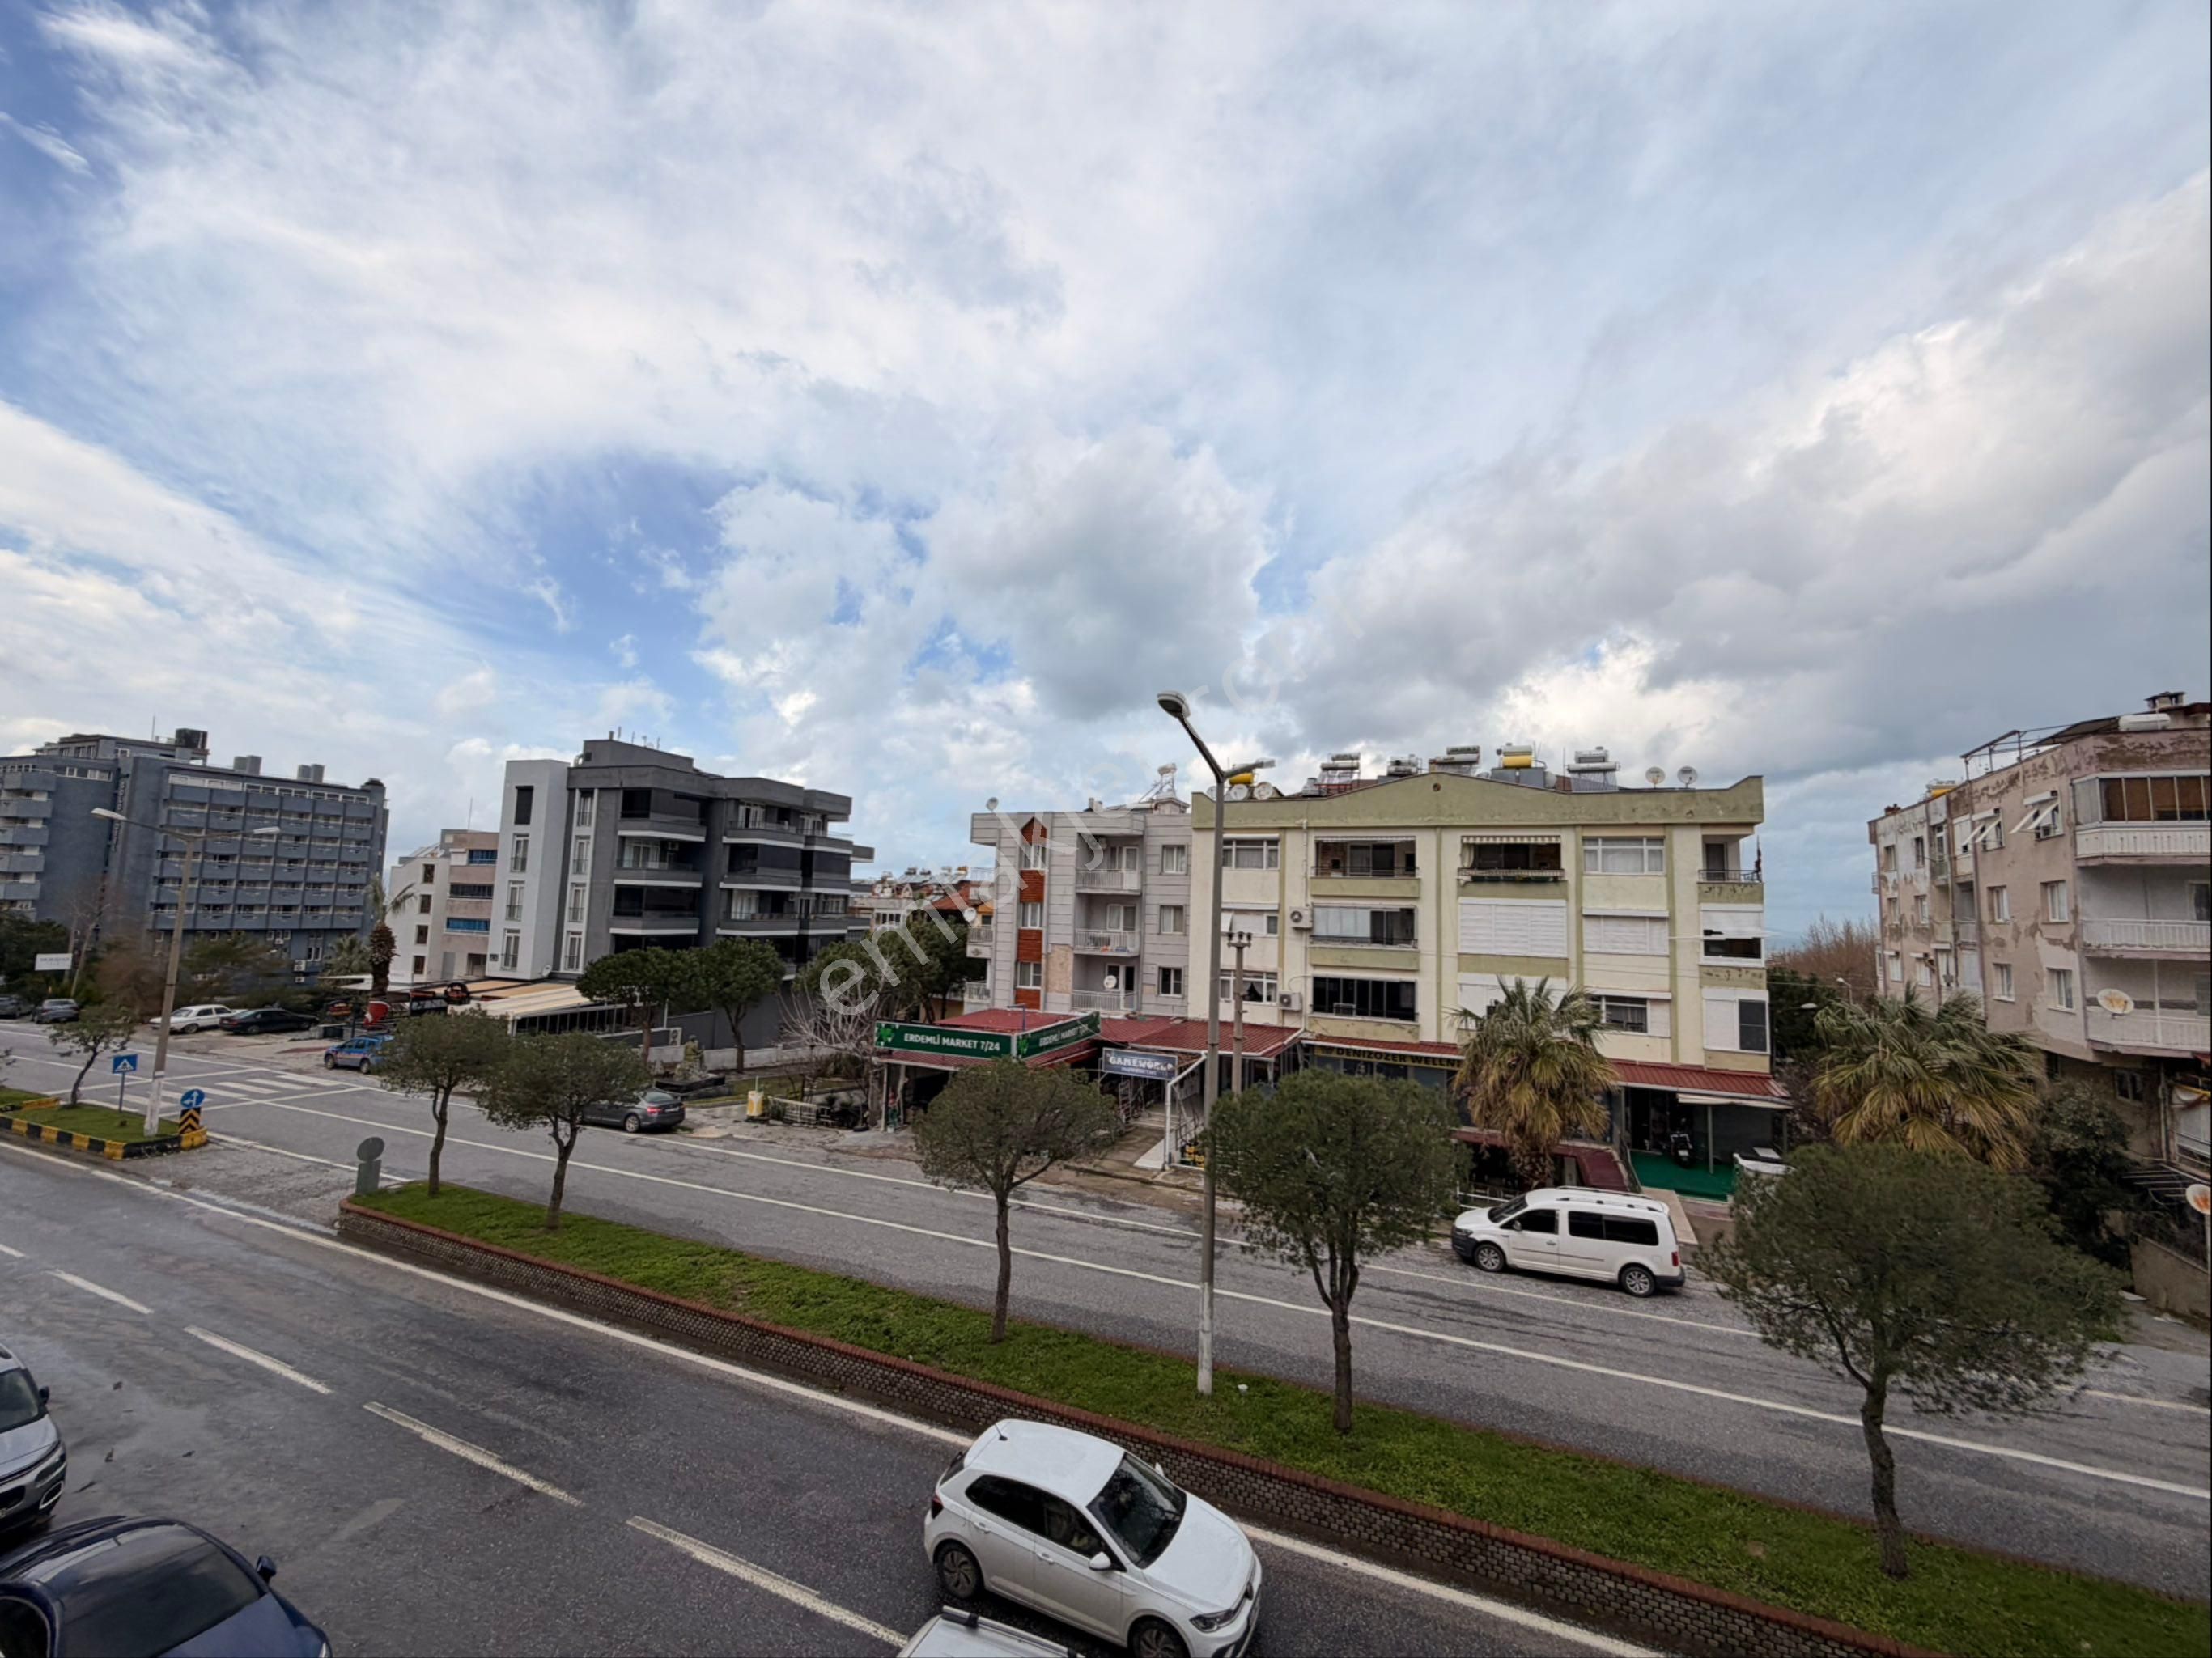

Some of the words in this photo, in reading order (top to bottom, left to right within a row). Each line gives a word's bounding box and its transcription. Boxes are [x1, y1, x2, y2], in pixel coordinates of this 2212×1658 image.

[903, 1033, 940, 1045] ERDEMLİ
[941, 1037, 979, 1050] MARKET
[979, 1041, 1001, 1052] 7/24
[1109, 1056, 1174, 1071] GAMEWORLD
